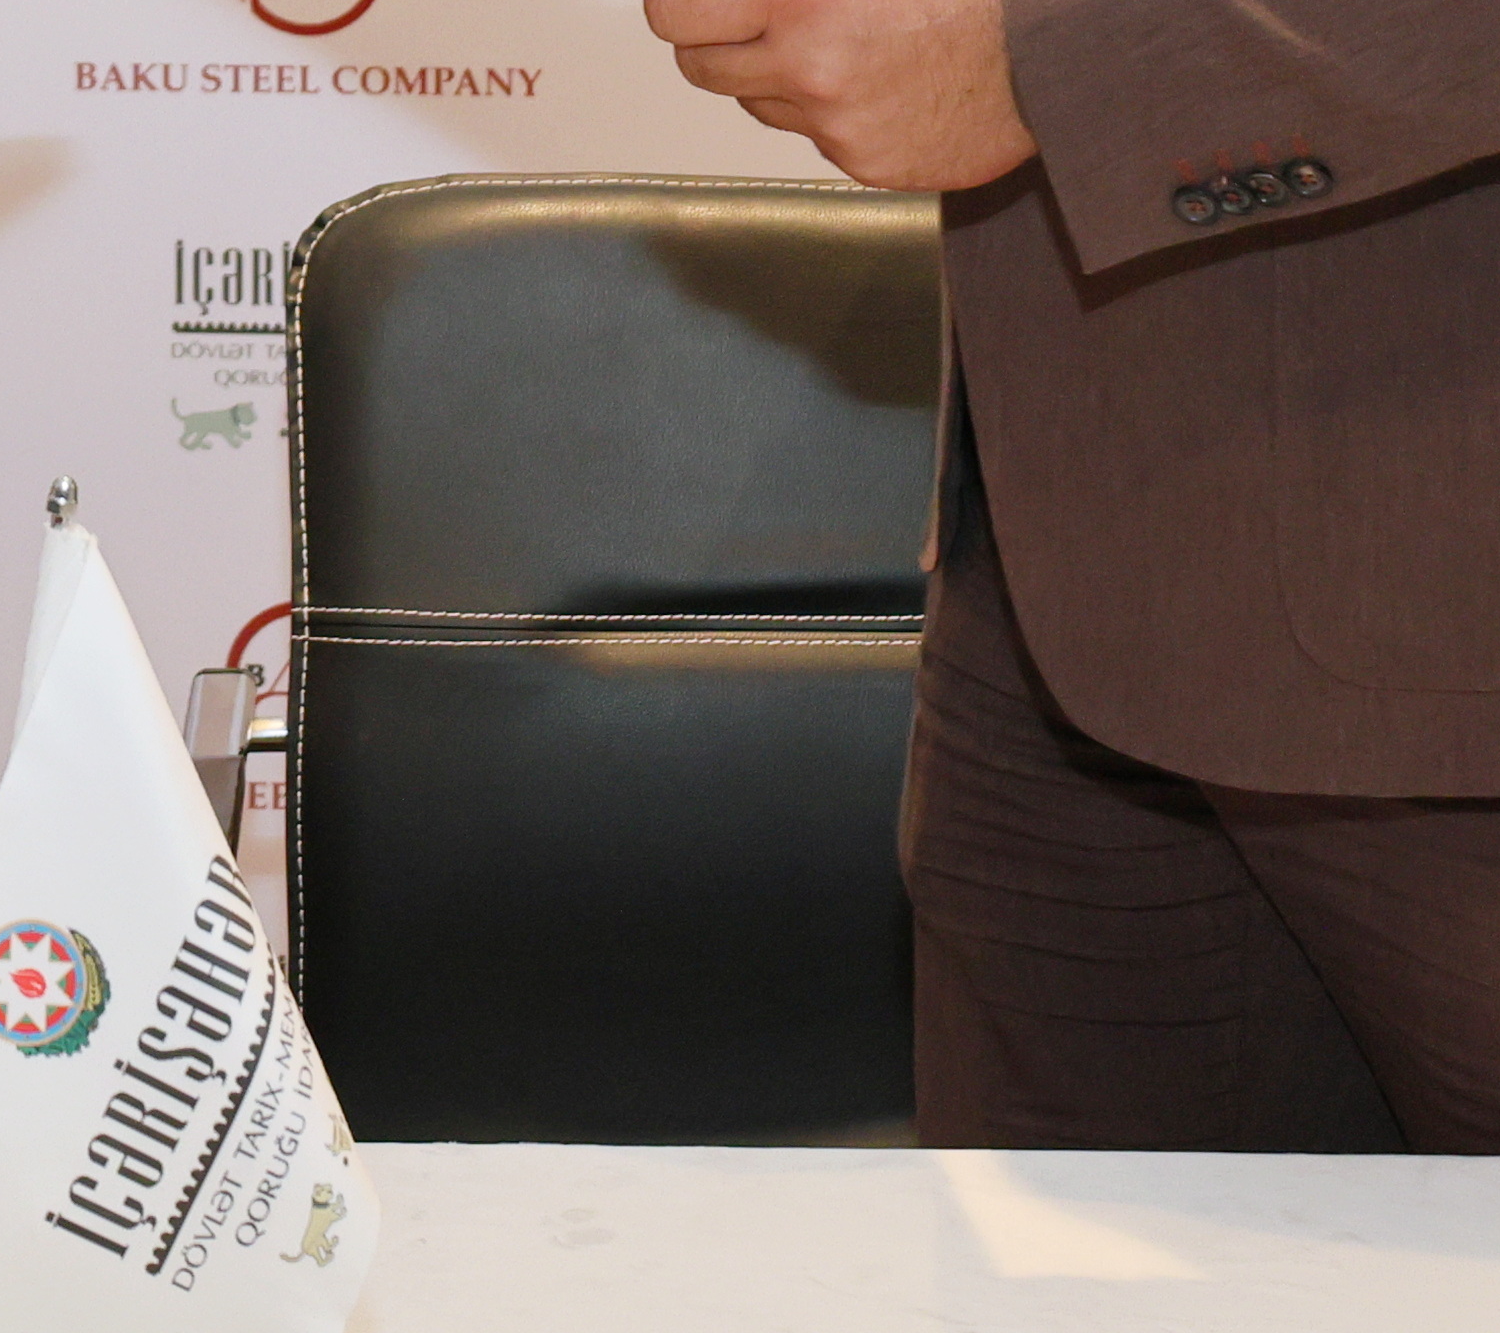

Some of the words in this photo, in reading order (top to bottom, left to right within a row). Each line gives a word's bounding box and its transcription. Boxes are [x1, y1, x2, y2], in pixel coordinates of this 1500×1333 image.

[75, 62, 188, 93] BAKU
[201, 64, 321, 95] STEEL
[332, 65, 542, 98] COMPANY
